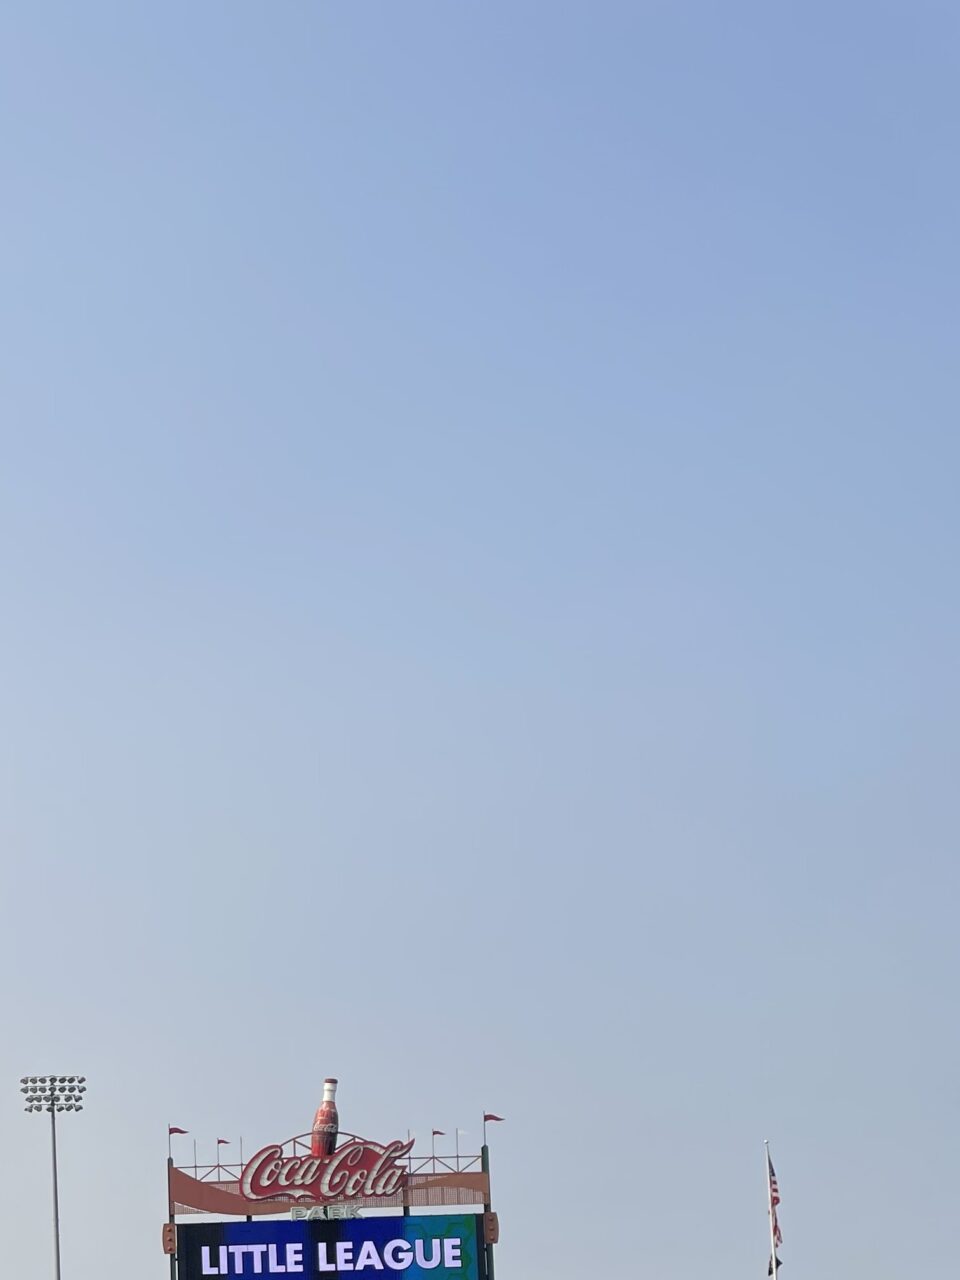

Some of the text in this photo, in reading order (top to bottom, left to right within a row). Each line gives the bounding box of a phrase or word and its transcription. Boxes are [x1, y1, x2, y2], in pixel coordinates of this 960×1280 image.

[242, 1141, 413, 1200] Coca-Cola
[291, 1204, 365, 1221] PARK
[200, 1237, 462, 1275] LITTLE LEAGUE
